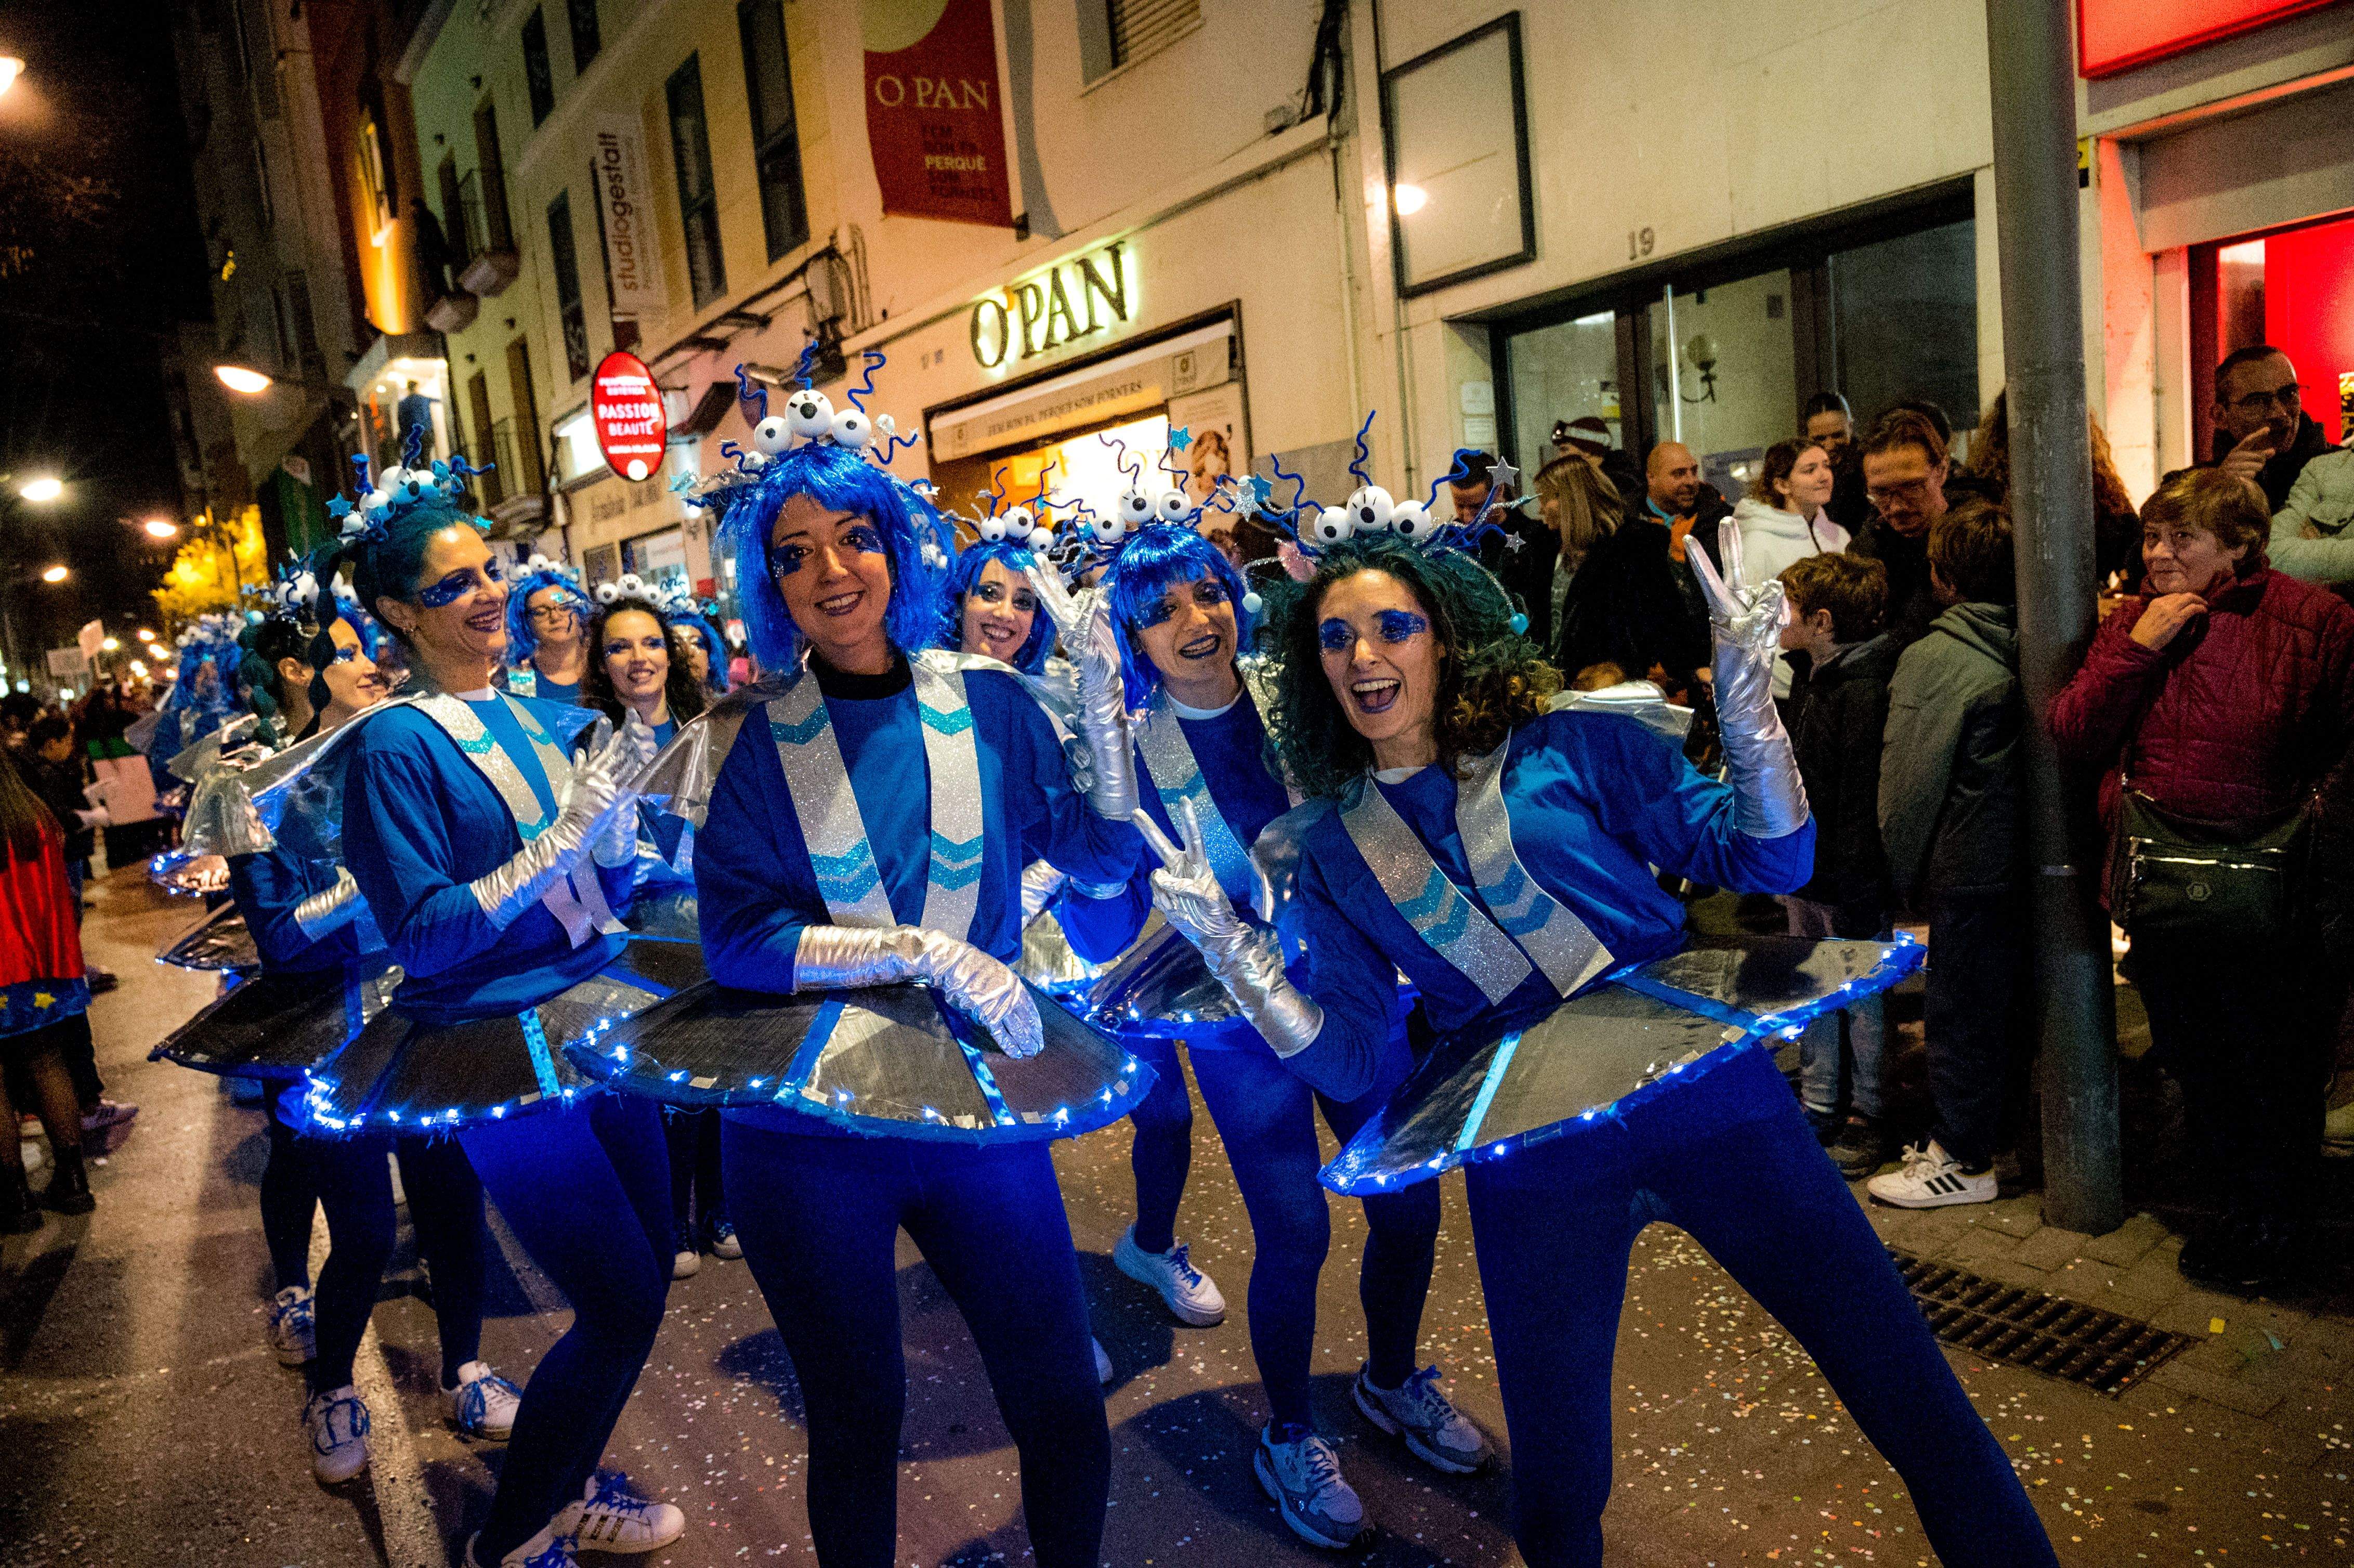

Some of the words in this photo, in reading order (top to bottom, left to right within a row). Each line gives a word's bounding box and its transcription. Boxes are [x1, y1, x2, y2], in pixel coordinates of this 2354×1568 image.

[598, 132, 638, 292] studiogestalt
[1627, 227, 1654, 261] 19
[598, 402, 660, 419] PASSION
